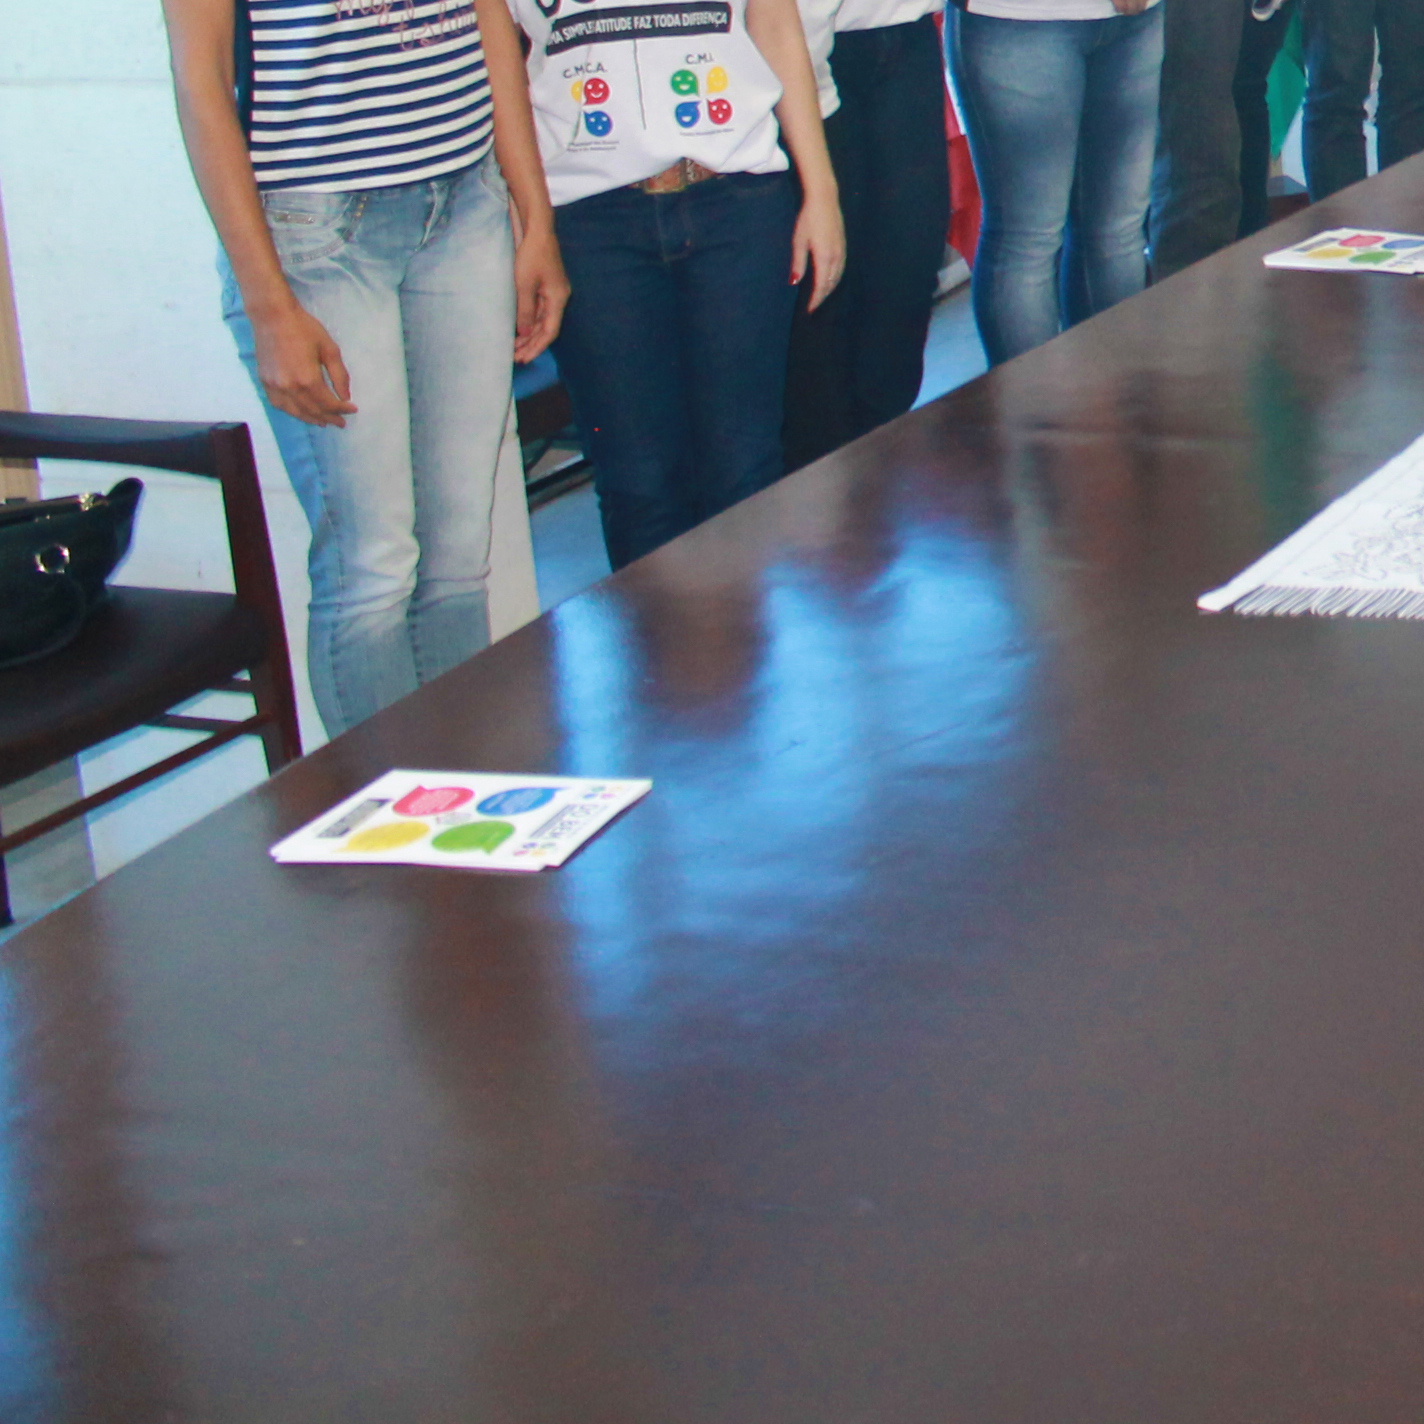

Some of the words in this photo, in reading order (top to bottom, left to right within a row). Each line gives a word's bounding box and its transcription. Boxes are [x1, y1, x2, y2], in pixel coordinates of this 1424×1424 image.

[550, 31, 564, 44] MA
[563, 22, 593, 41] SIMPLE
[595, 16, 632, 34] ATITUDE
[633, 14, 652, 31] FAZ
[653, 13, 682, 29] TODA
